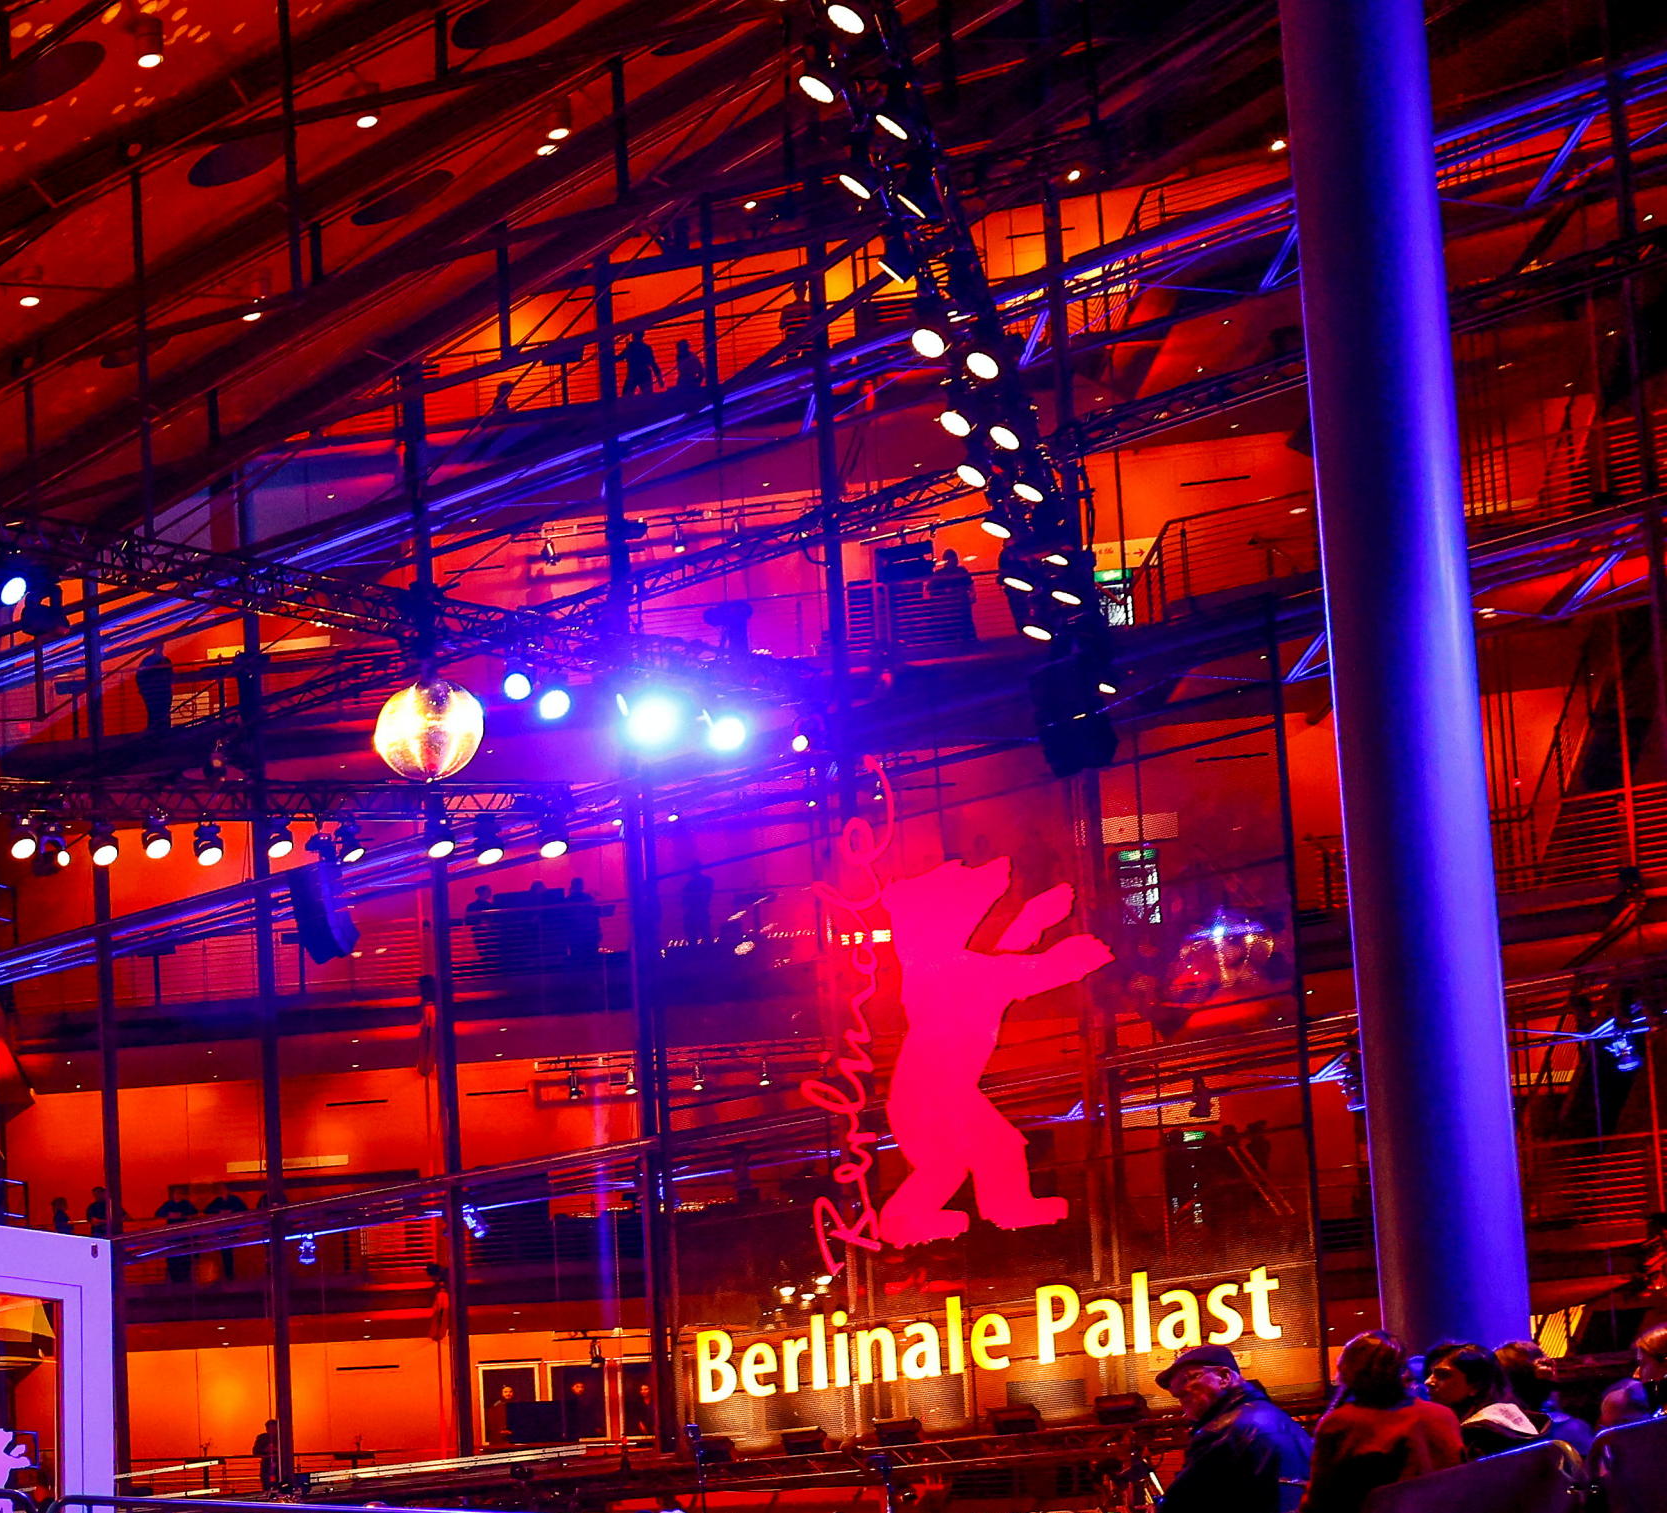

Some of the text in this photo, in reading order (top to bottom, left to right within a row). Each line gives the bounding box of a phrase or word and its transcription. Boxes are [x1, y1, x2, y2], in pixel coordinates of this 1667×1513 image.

[800, 753, 895, 1276] Berlinale
[695, 1265, 1284, 1404] Berlinale Palast
